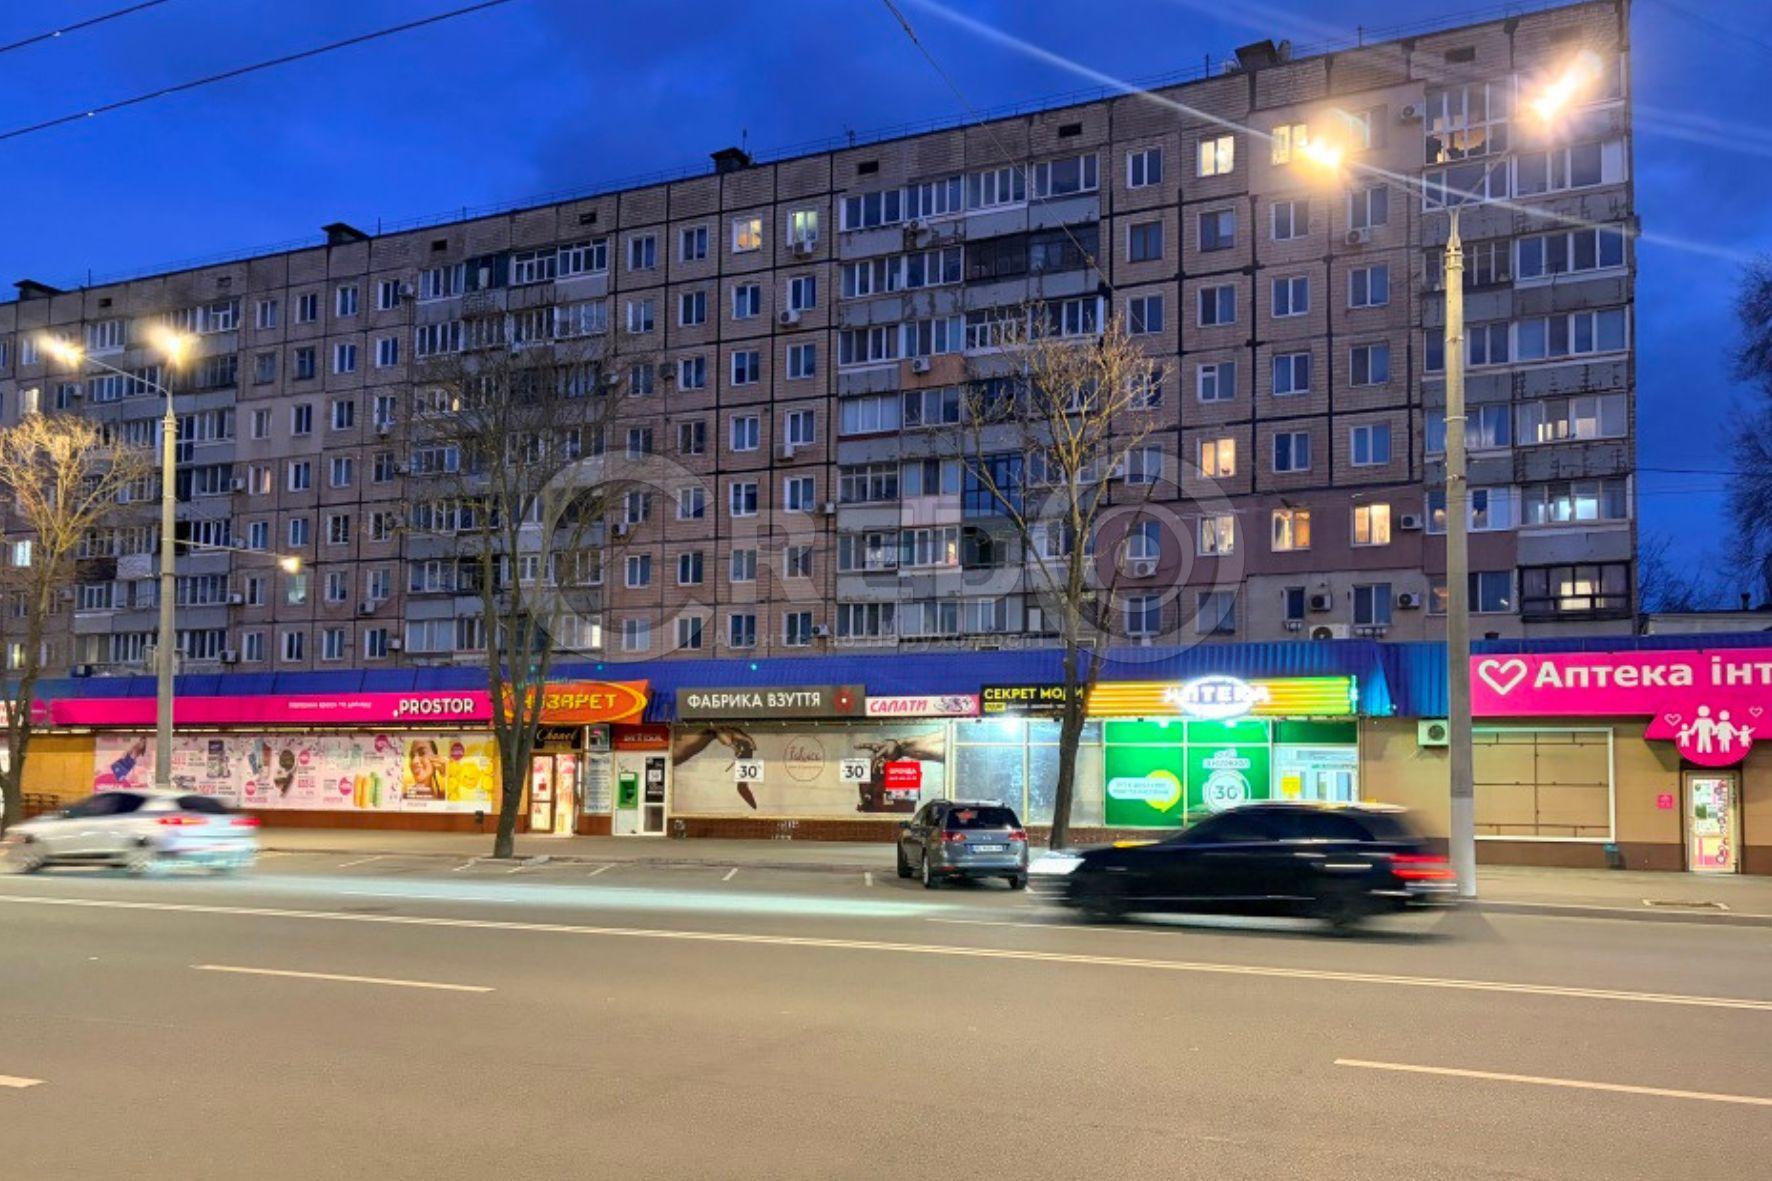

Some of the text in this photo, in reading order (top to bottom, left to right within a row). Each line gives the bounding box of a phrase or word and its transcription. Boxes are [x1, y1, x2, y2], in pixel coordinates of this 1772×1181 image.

[1534, 661, 1693, 688] Аптека
[687, 692, 821, 709] ФАБРИКА ВЗУТТЯ
[984, 686, 1083, 700] СЕКРЕТ МОИ
[521, 694, 617, 710] ЗАРЕТ
[870, 699, 928, 713] САЛАТИ
